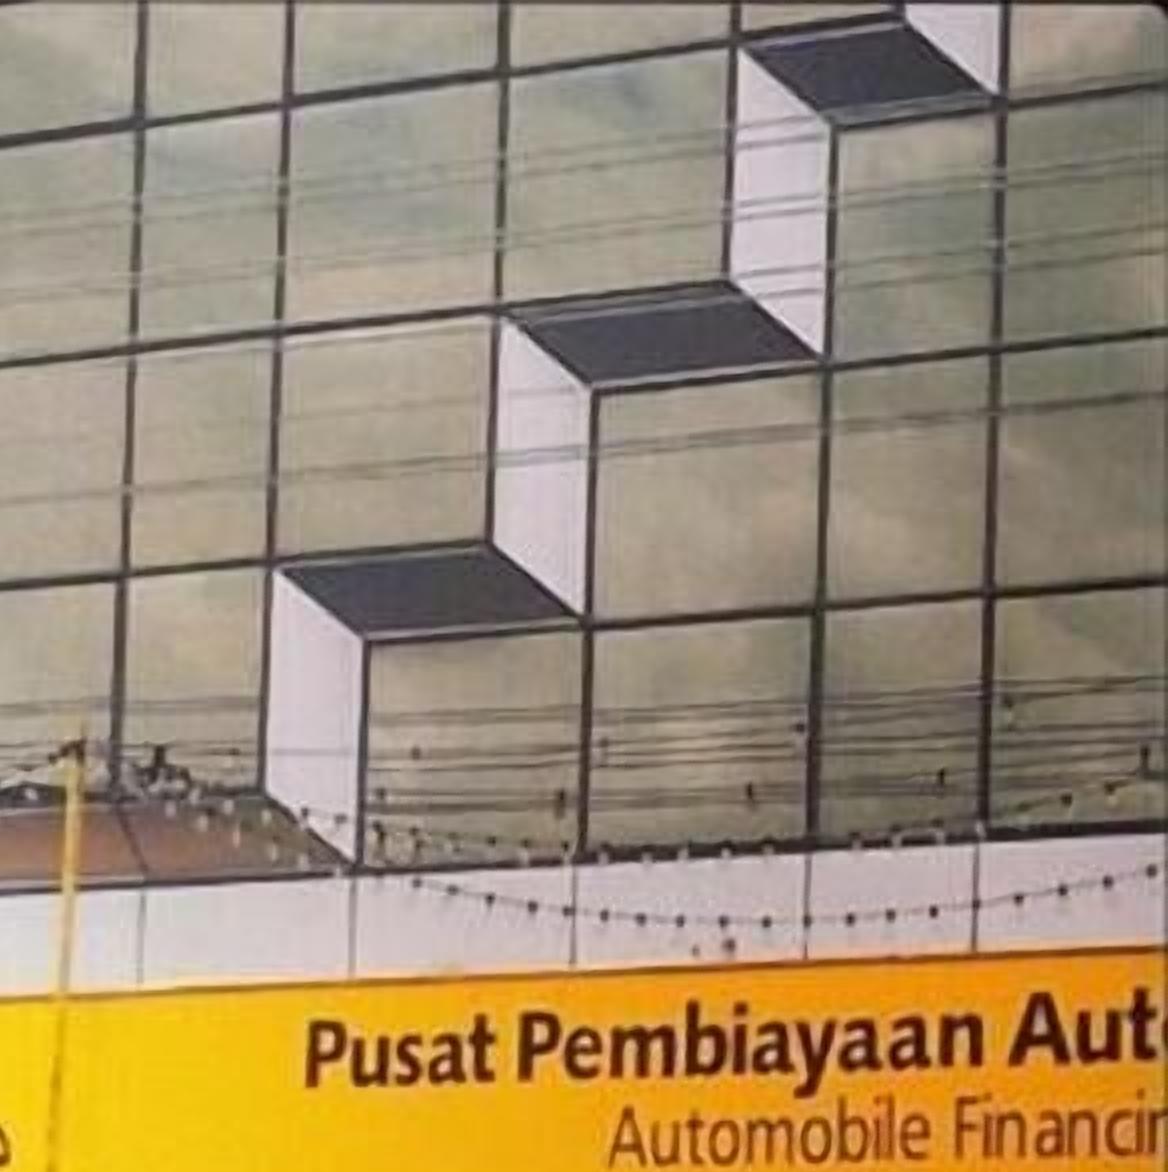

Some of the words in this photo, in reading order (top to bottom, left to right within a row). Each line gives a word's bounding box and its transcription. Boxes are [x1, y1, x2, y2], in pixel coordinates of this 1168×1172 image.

[305, 1013, 496, 1089] Pusat
[517, 999, 984, 1099] Pembiayaan
[1008, 986, 1167, 1067] Aut
[607, 1094, 931, 1167] Automobile
